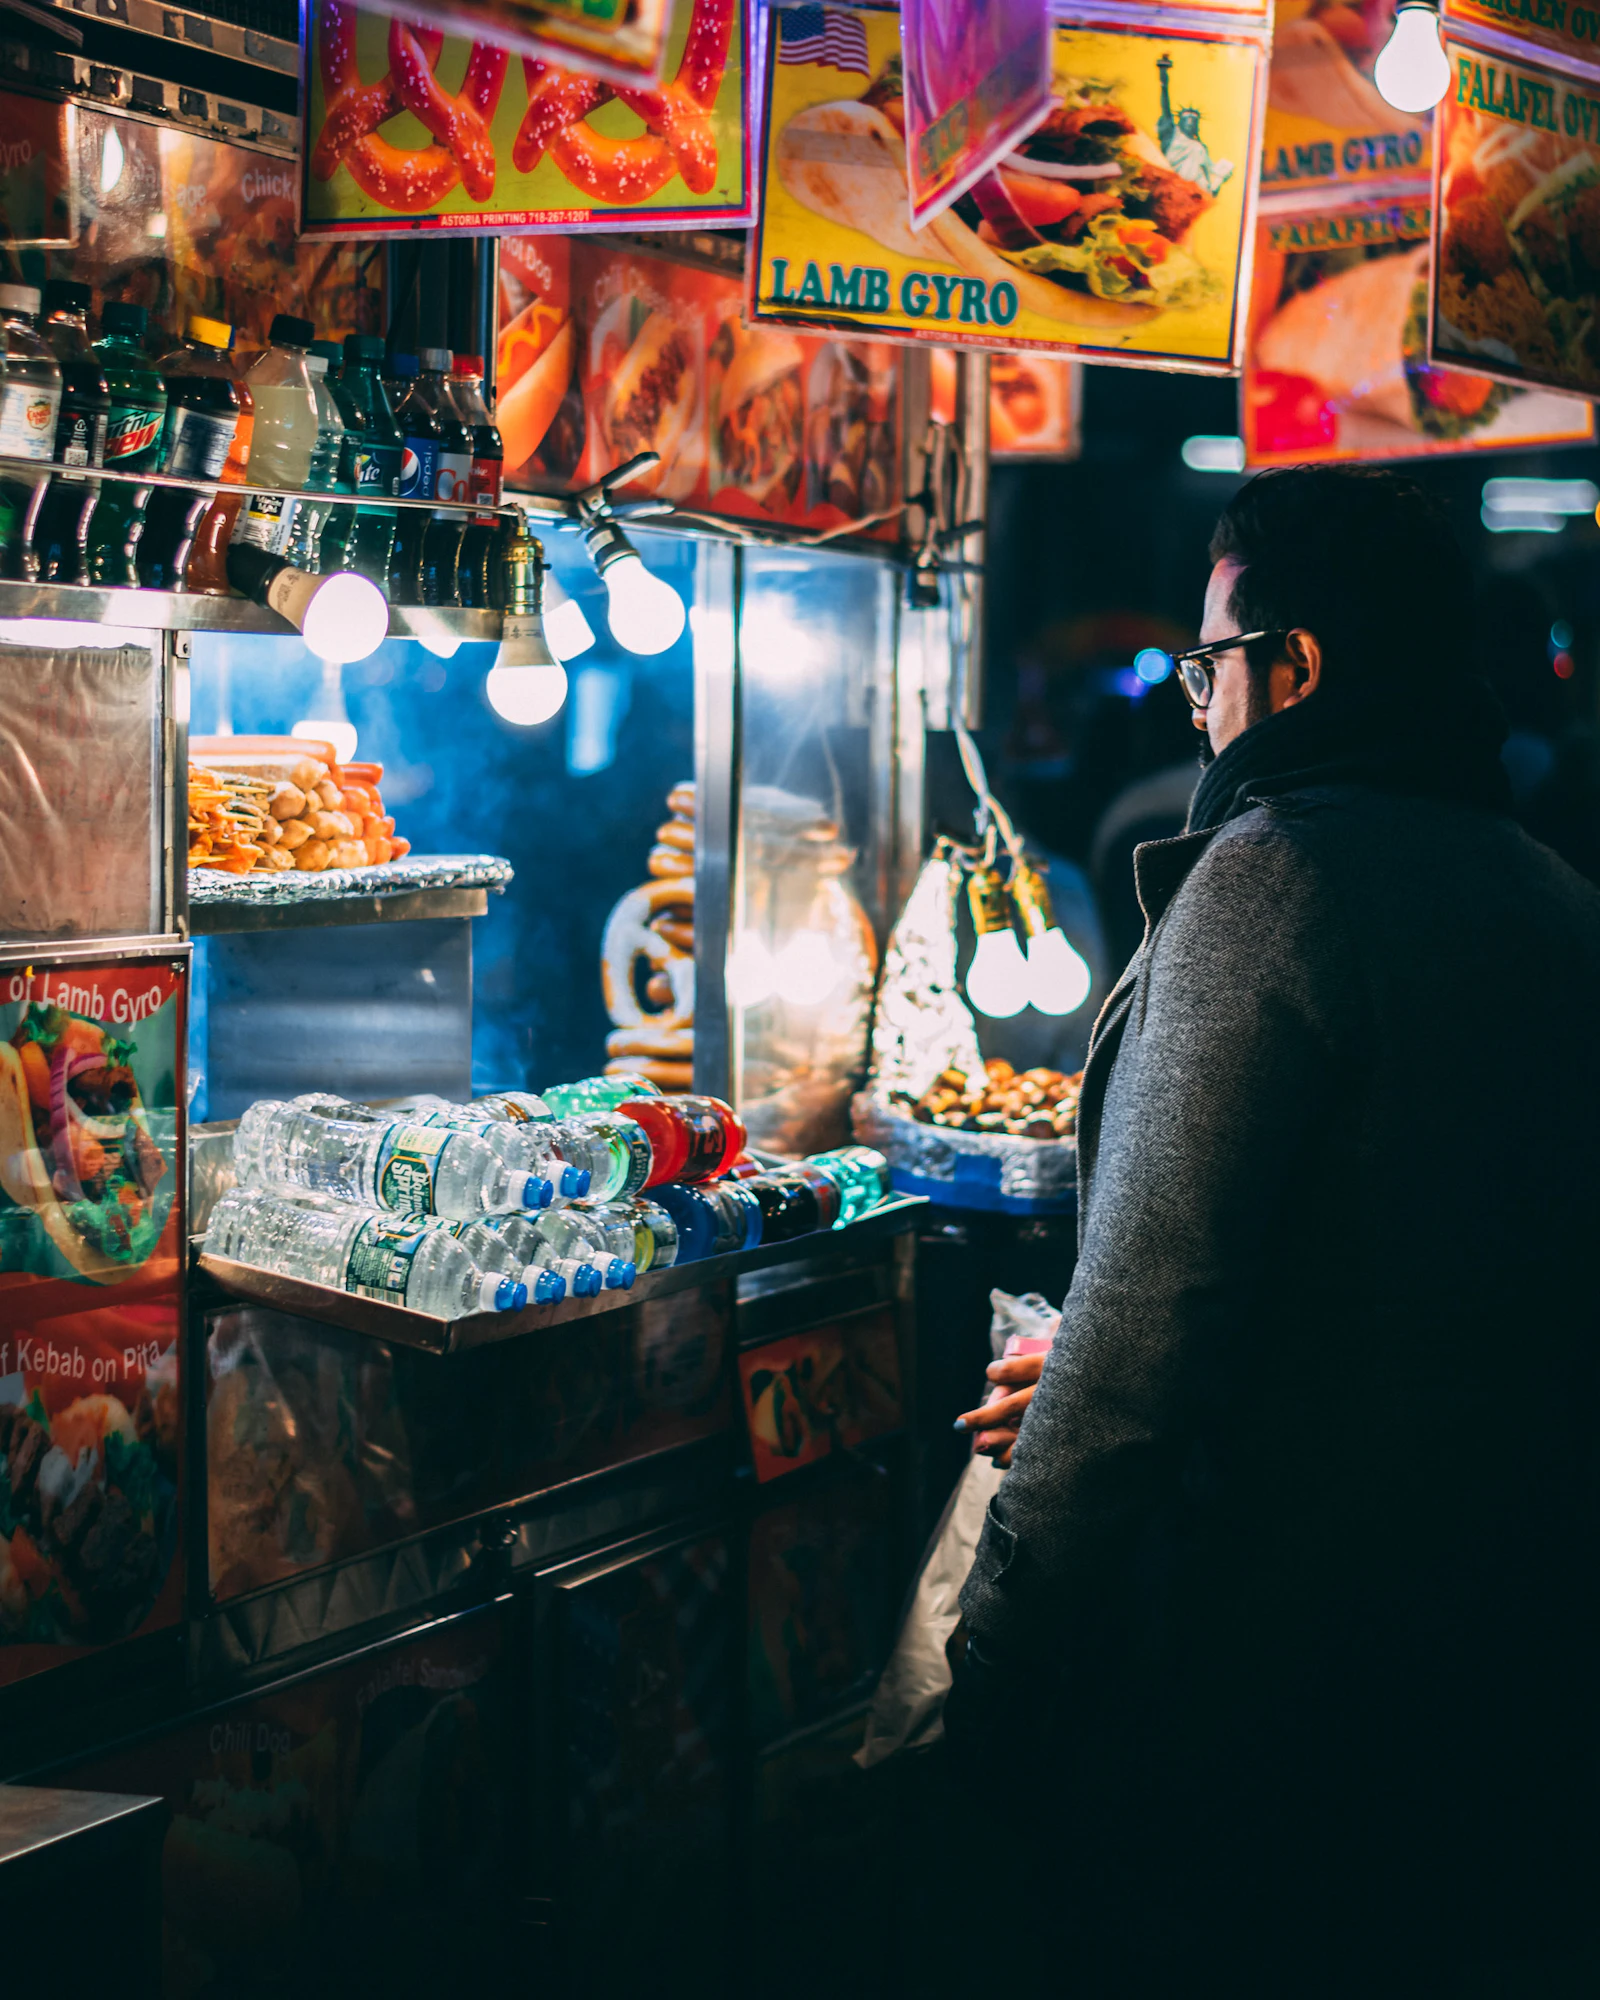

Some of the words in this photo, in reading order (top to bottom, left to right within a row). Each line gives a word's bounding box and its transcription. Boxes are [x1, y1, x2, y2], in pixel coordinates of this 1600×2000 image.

[1457, 57, 1559, 131] FALAFEL
[1563, 93, 1600, 145] OV
[0, 138, 32, 177] yro
[1342, 130, 1422, 172] GYRO
[441, 214, 482, 226] ASTORIA
[482, 212, 526, 225] PRINTING
[529, 210, 590, 224] 718-267-1201
[526, 244, 552, 291] Dog
[771, 258, 889, 313] LAMB
[901, 272, 1018, 326] GYRO
[915, 329, 959, 341] ASTORIA
[43, 970, 105, 1020] Lamb
[111, 985, 162, 1032] Gyro
[17, 1338, 86, 1379] Kebab
[92, 1357, 117, 1383] on
[123, 1340, 161, 1380] Pita
